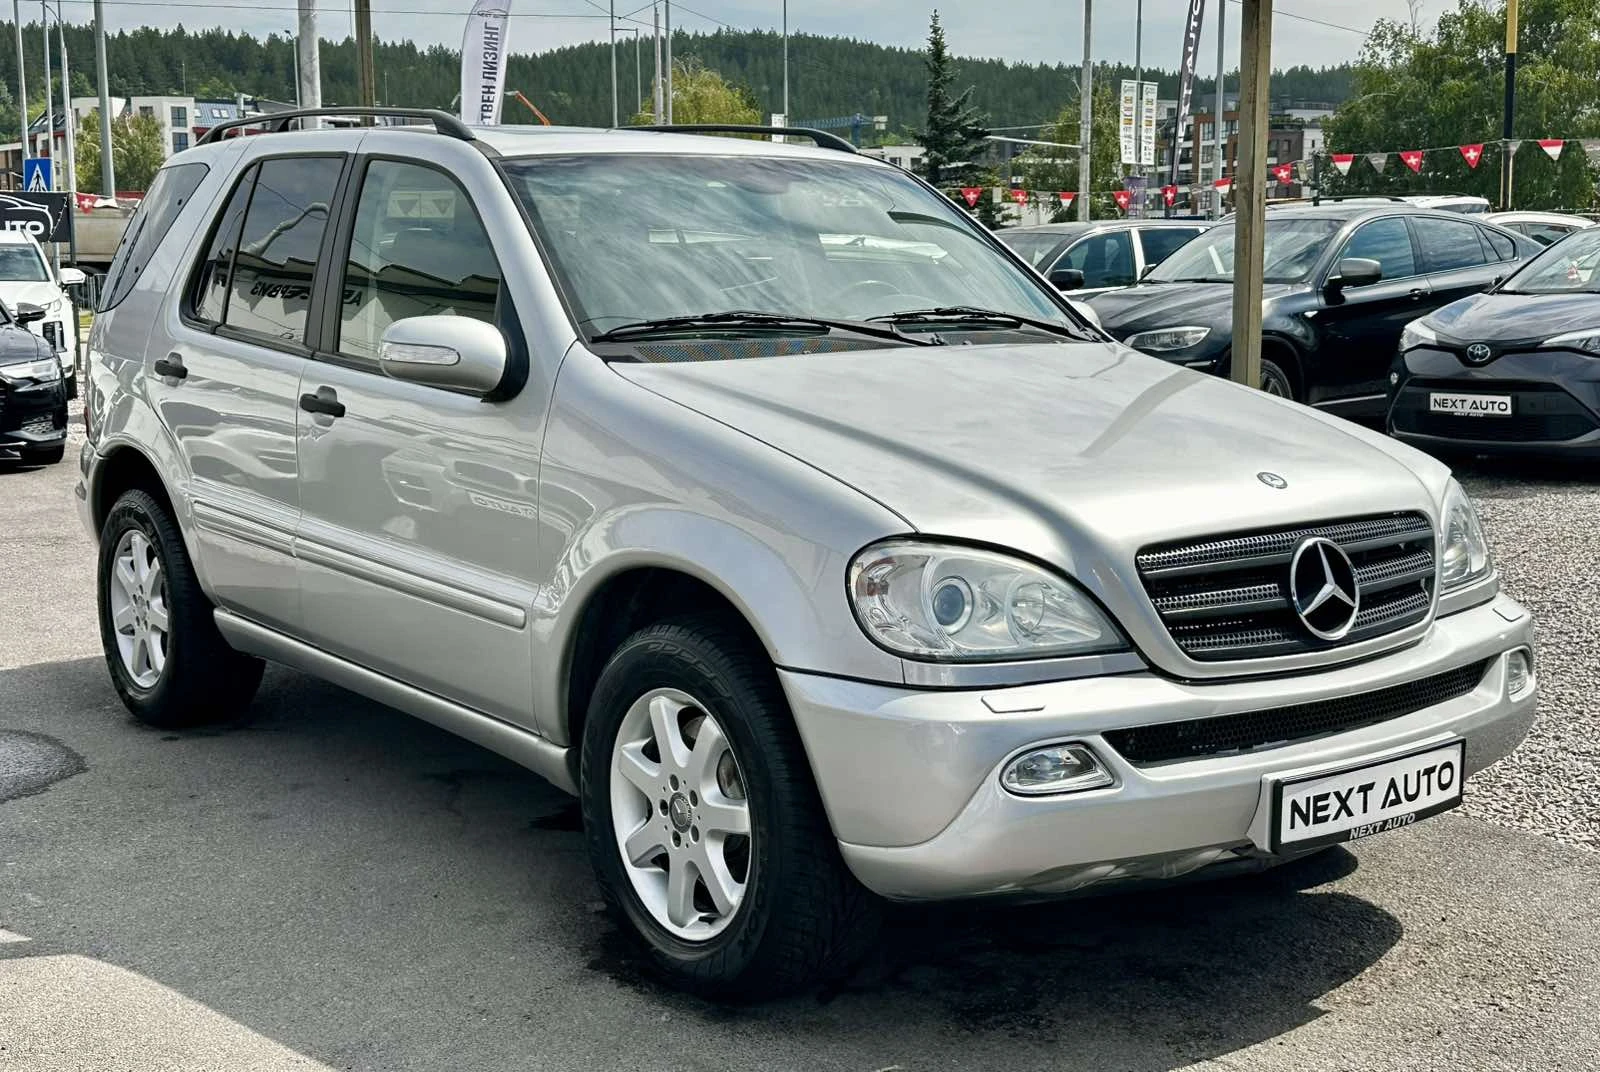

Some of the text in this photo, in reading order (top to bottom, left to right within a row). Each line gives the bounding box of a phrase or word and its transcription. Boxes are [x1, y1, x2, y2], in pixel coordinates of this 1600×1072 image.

[482, 22, 499, 81] ЛИЗИНГ
[480, 85, 496, 123] ТВЕН
[1433, 398, 1508, 412] NEXT AUTO
[1289, 760, 1455, 830] NEXT AUTO
[1350, 812, 1416, 840] NEXT AUTO
